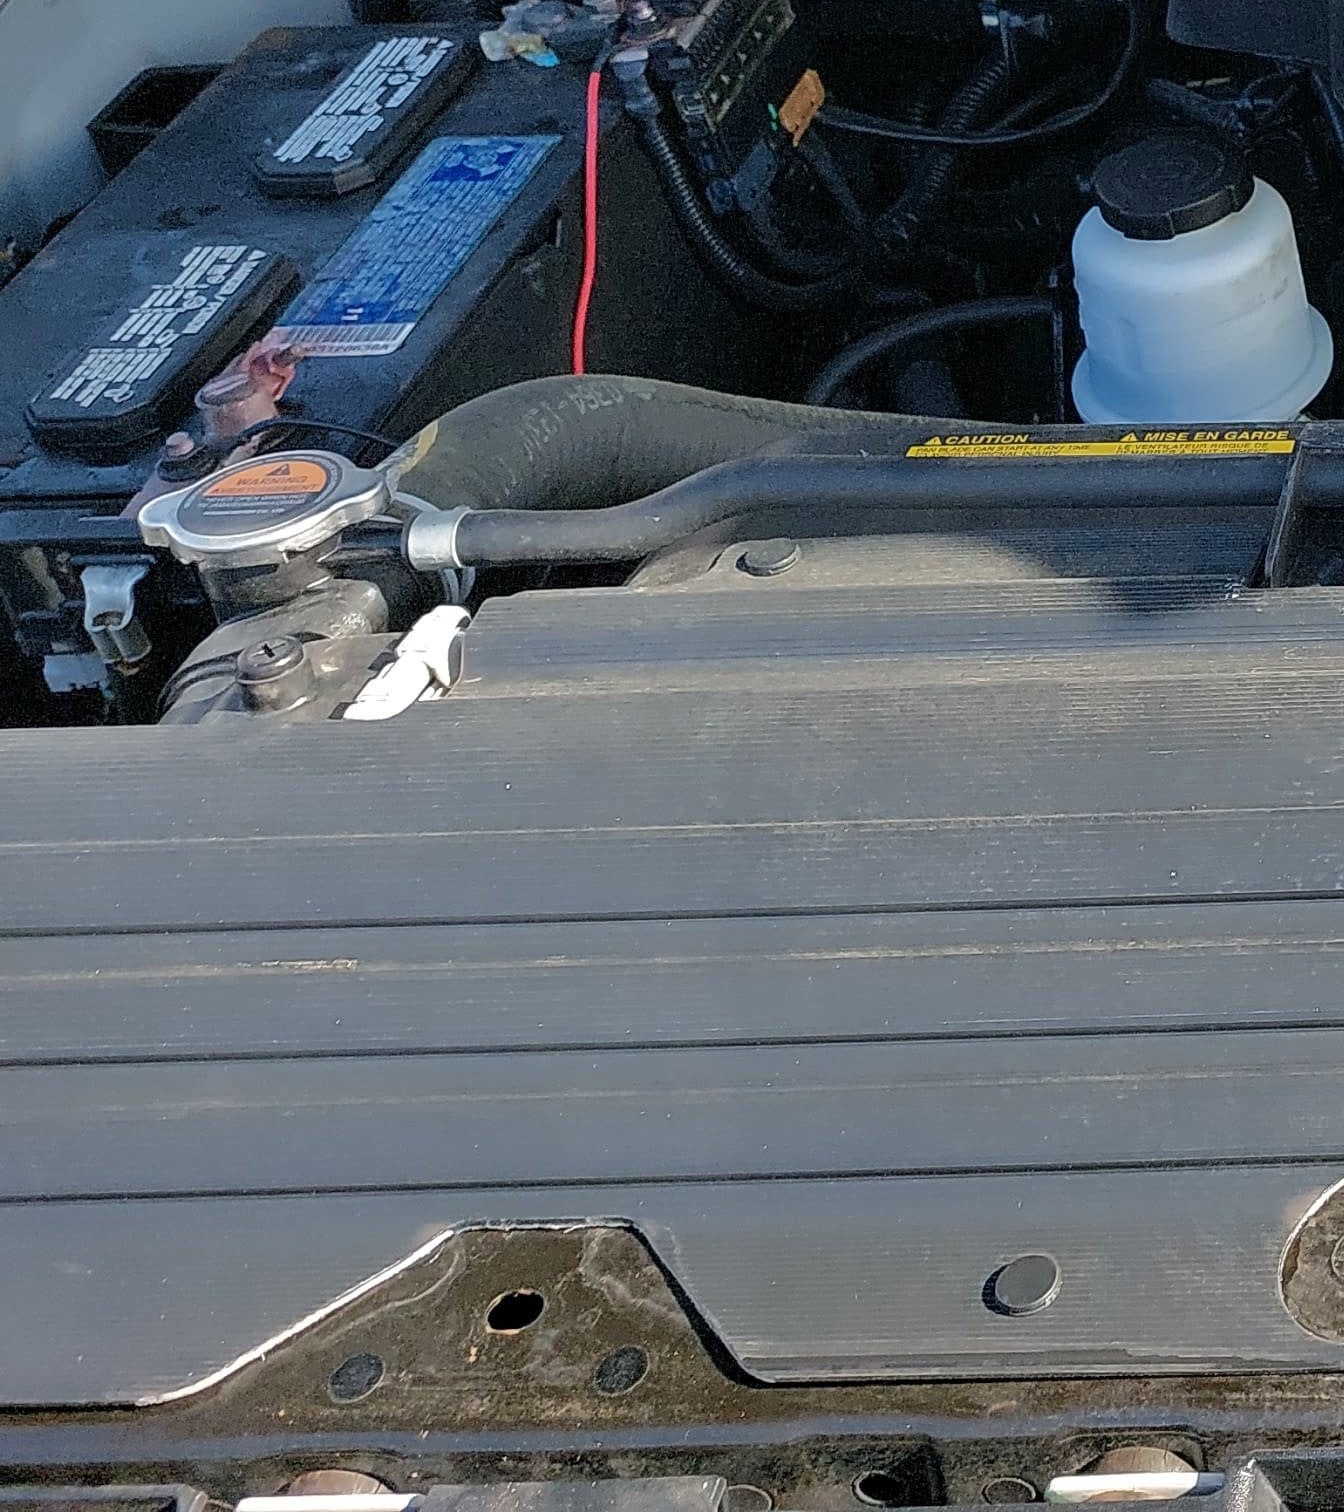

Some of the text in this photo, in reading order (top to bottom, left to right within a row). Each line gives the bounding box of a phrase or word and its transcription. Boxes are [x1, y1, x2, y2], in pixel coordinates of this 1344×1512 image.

[945, 434, 1029, 445] CAUTION
[1144, 430, 1289, 441] MISE EN GARDE
[236, 476, 308, 485] WARNING
